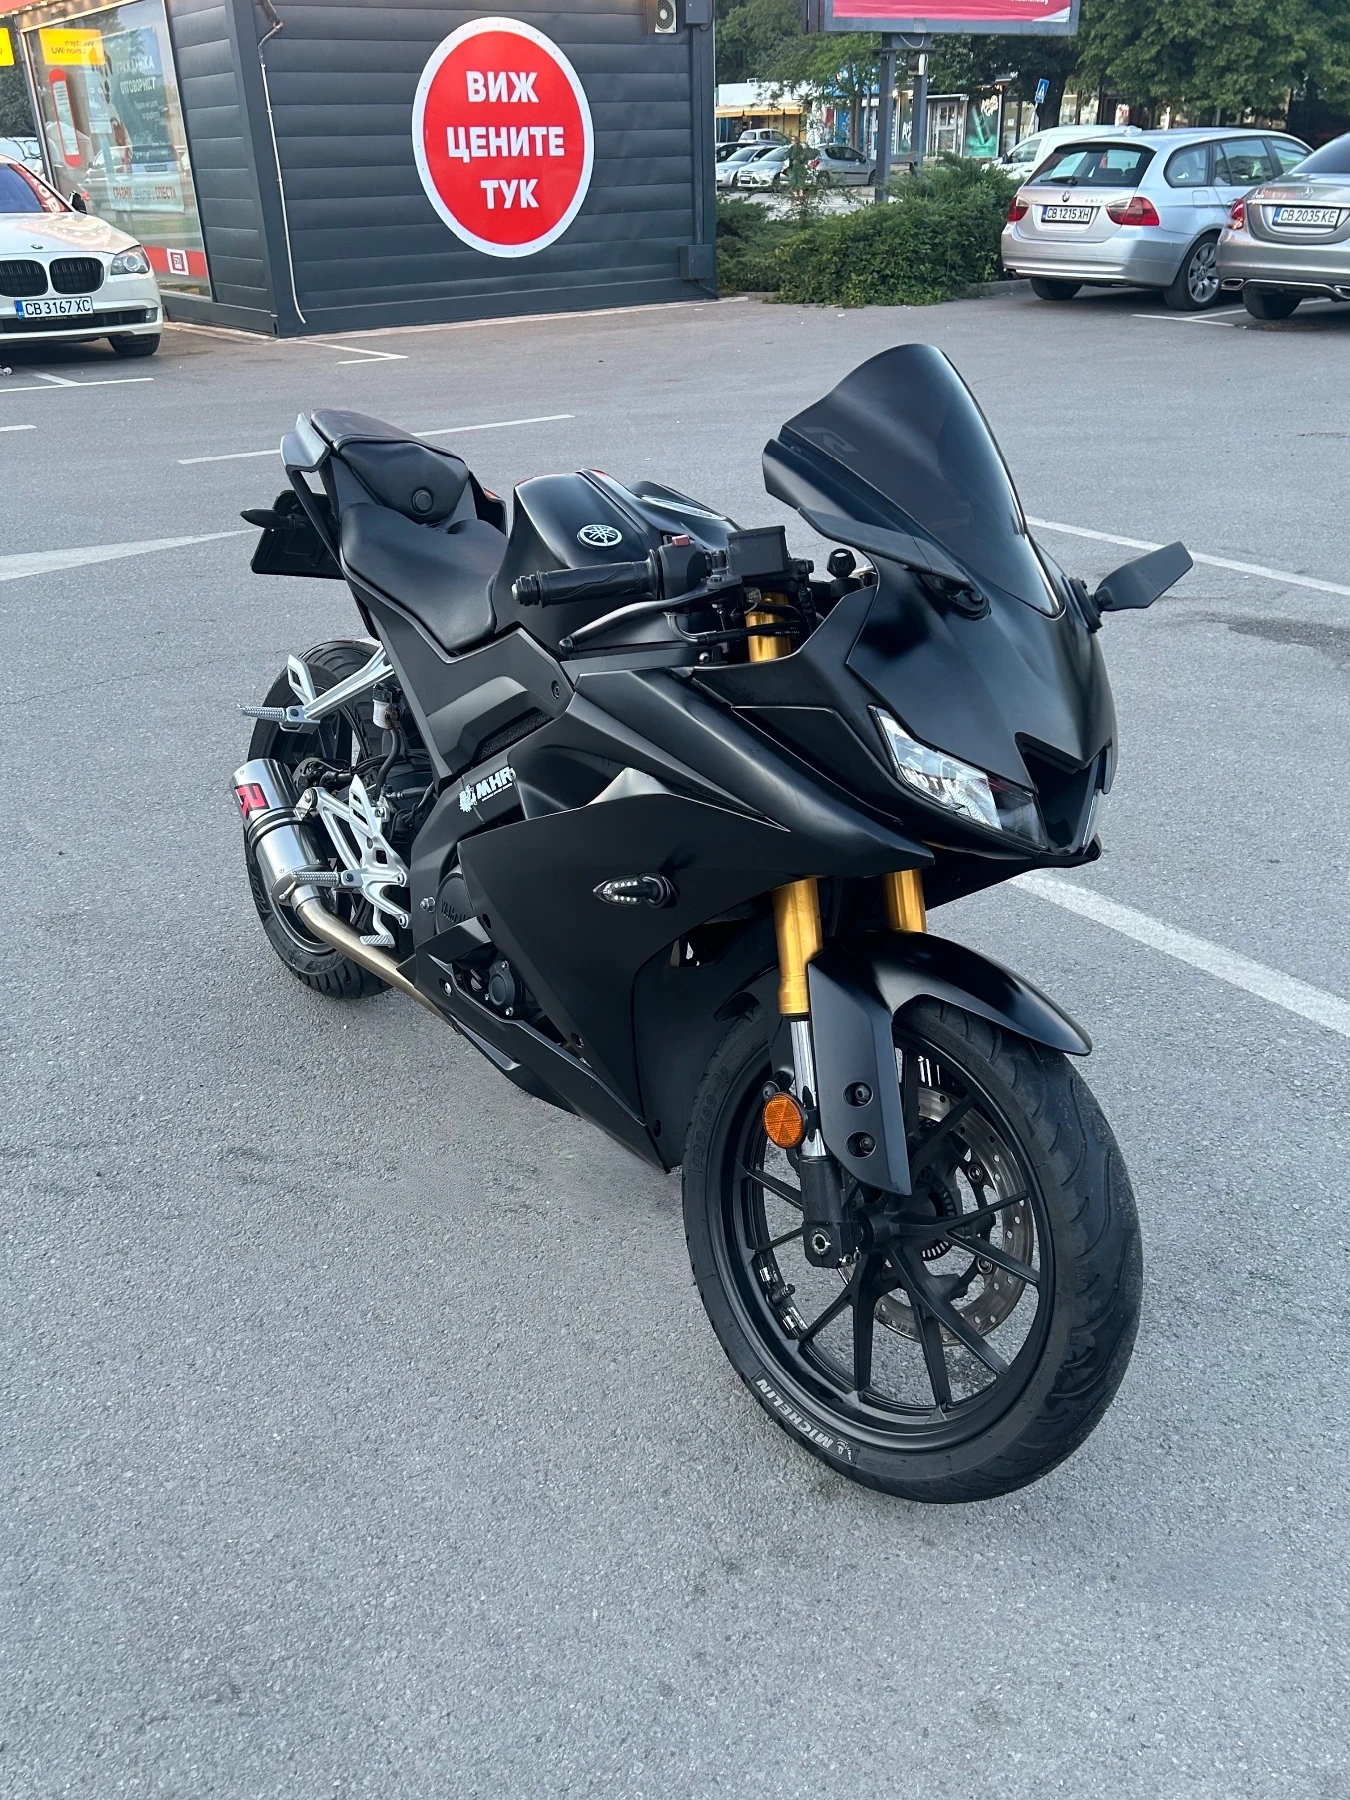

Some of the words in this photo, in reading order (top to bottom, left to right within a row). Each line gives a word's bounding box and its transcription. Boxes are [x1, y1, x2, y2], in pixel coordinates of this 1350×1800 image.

[466, 70, 539, 103] ВИЖ
[446, 126, 565, 163] ЦЕНИТЕ
[480, 178, 540, 209] ТУК
[1046, 207, 1058, 219] CB
[1059, 208, 1077, 219] 1215
[1077, 208, 1090, 220] XH
[1280, 209, 1295, 221] CB
[1295, 210, 1320, 222] 2035
[1320, 210, 1337, 223] KE
[25, 302, 42, 315] CB
[44, 301, 72, 314] 3167
[75, 299, 91, 312] XC
[755, 1378, 834, 1449] MICHELIN
